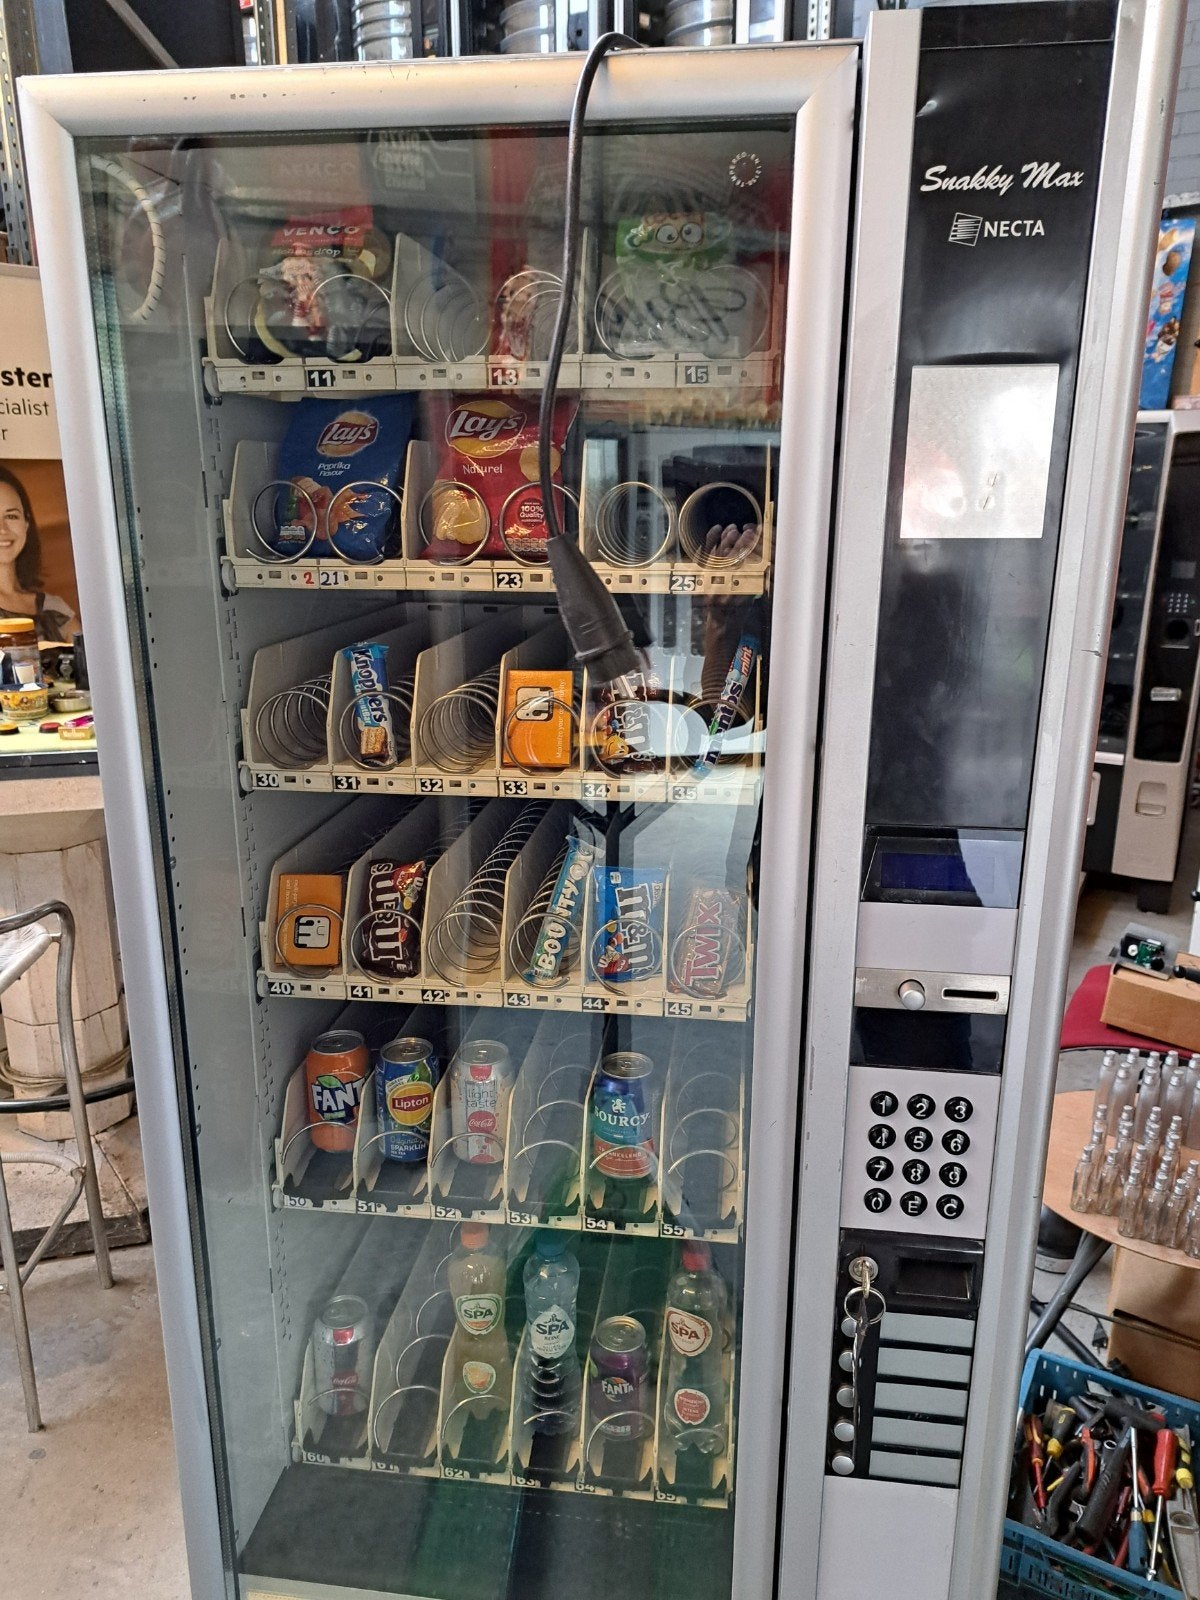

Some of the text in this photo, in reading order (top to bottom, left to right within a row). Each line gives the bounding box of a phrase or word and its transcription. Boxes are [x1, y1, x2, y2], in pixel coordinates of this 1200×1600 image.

[920, 161, 1084, 196] Snakky Max
[283, 225, 360, 237] VENCO
[984, 220, 1045, 237] NECTA
[0, 367, 52, 388] ster
[310, 370, 332, 387] 11
[493, 368, 518, 385] 13
[685, 366, 709, 384] 15
[450, 410, 522, 442] Lay's
[321, 423, 376, 446] Lay's
[317, 461, 351, 471] Paprika
[462, 463, 503, 476] Naturel
[519, 511, 545, 520] Quality
[521, 504, 544, 513] 100%
[303, 571, 315, 586] 2
[320, 571, 340, 586] 21
[497, 573, 522, 588] 23
[670, 575, 695, 592] 25
[741, 646, 752, 677] mint
[257, 773, 279, 787] 30
[336, 776, 358, 790] 31
[420, 778, 443, 792] 32
[504, 780, 527, 795] 33
[584, 783, 607, 798] 34
[674, 786, 697, 801] 35
[537, 879, 580, 971] BOUNTY
[684, 901, 724, 988] TWIX
[270, 982, 292, 995] 40
[352, 985, 373, 998] 41
[422, 990, 444, 1002] 42
[508, 993, 530, 1007] 43
[582, 997, 605, 1010] 44
[669, 1002, 692, 1016] 45
[311, 1077, 366, 1111] FANT
[468, 1088, 495, 1101] light
[394, 1096, 429, 1110] Lipton
[466, 1100, 497, 1109] taste
[879, 1099, 966, 1120] 1 2 3
[594, 1105, 651, 1128] SOURCY
[875, 1131, 962, 1152] 4 5 6
[874, 1164, 960, 1185] 7 8 9
[287, 1196, 306, 1207] 50
[357, 1200, 376, 1213] 51
[871, 1196, 957, 1217] 0 E C
[435, 1206, 456, 1218] 52
[510, 1211, 531, 1224] 53
[586, 1217, 607, 1229] 54
[663, 1223, 684, 1236] 55
[463, 1308, 493, 1320] SPA
[536, 1320, 570, 1336] SPA
[671, 1321, 700, 1340] SPA
[601, 1380, 634, 1395] FANTA
[444, 1467, 465, 1479] 62
